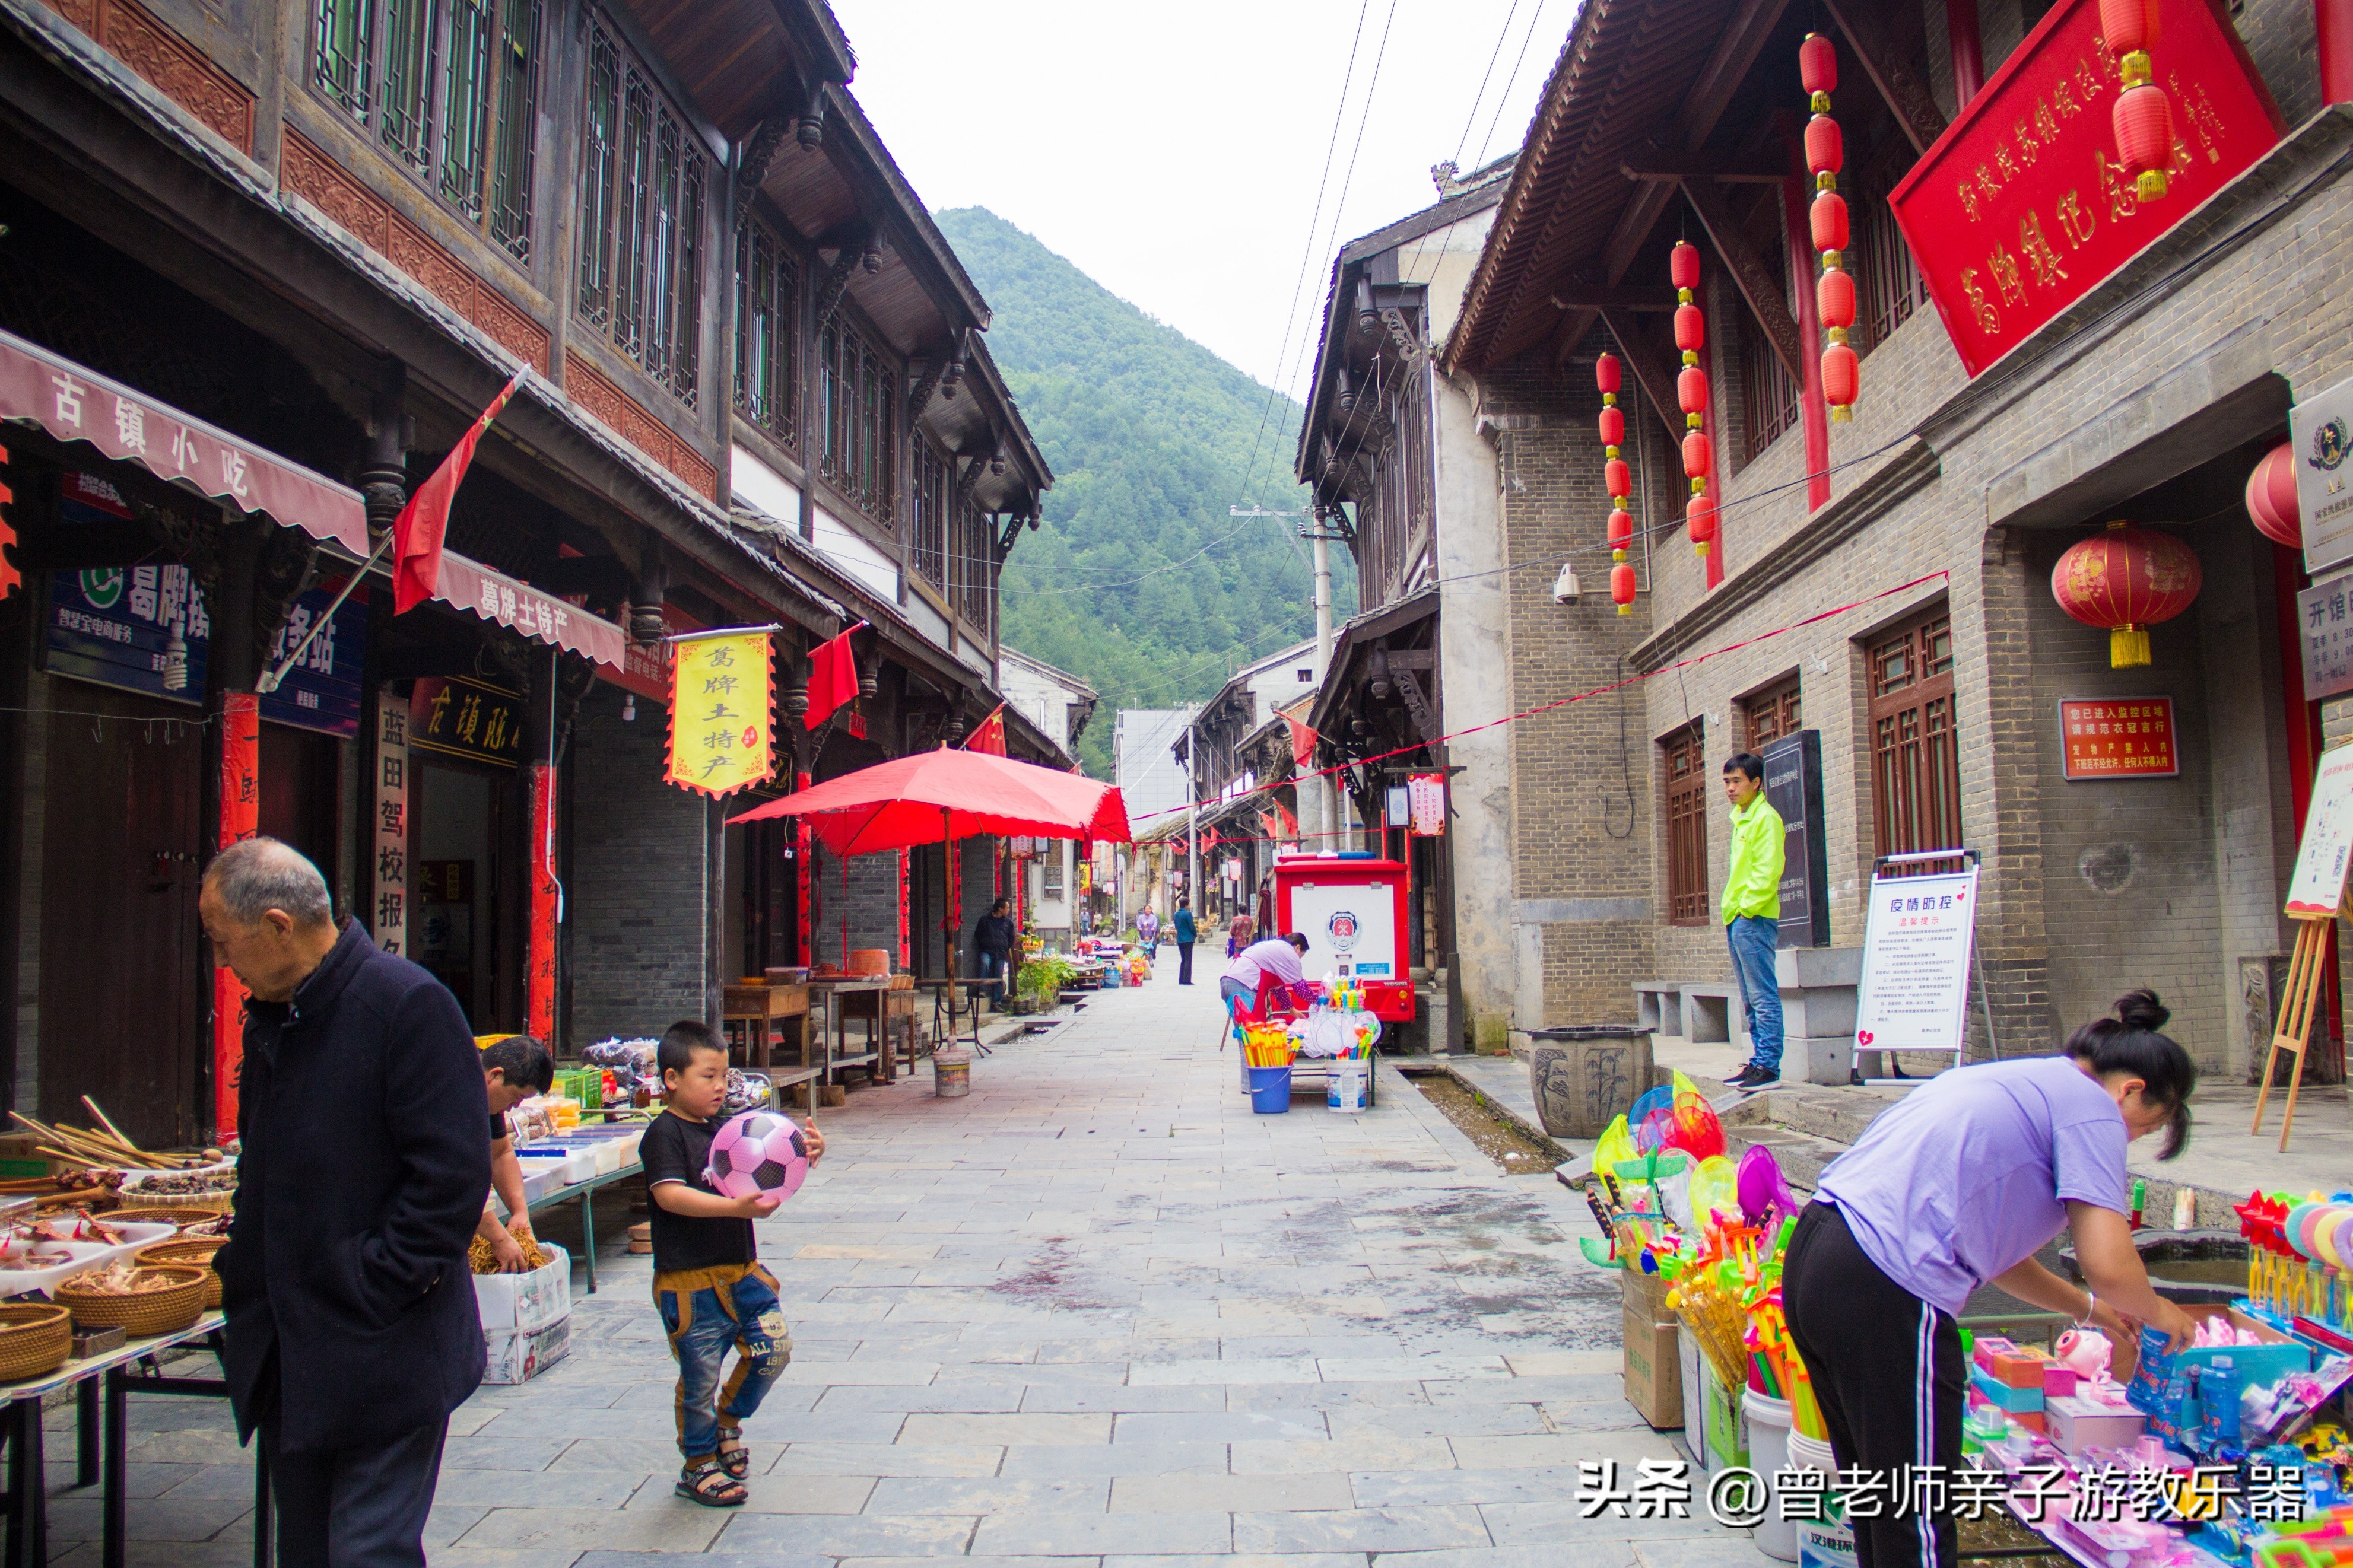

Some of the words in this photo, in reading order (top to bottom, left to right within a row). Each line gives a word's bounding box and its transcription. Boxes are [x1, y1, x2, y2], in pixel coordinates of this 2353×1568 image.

[52, 373, 248, 497] 古镇小吃
[480, 578, 568, 645] 葛牌土特产
[57, 608, 132, 644] 智慧宝电商服务
[2312, 635, 2327, 649] 夏季
[2314, 651, 2328, 665] 冬季
[701, 646, 739, 780] 葛牌土特产
[2070, 706, 2164, 720] 您已进入监控区域
[2072, 721, 2165, 736] 请规范衣冠言行
[2073, 742, 2167, 756] 宠物严禁入内
[1890, 895, 1952, 912] 疫情防控
[1898, 917, 1940, 927] 温馨提示
[749, 1341, 771, 1357] ALL
[1811, 1532, 1857, 1553] 汉港环
